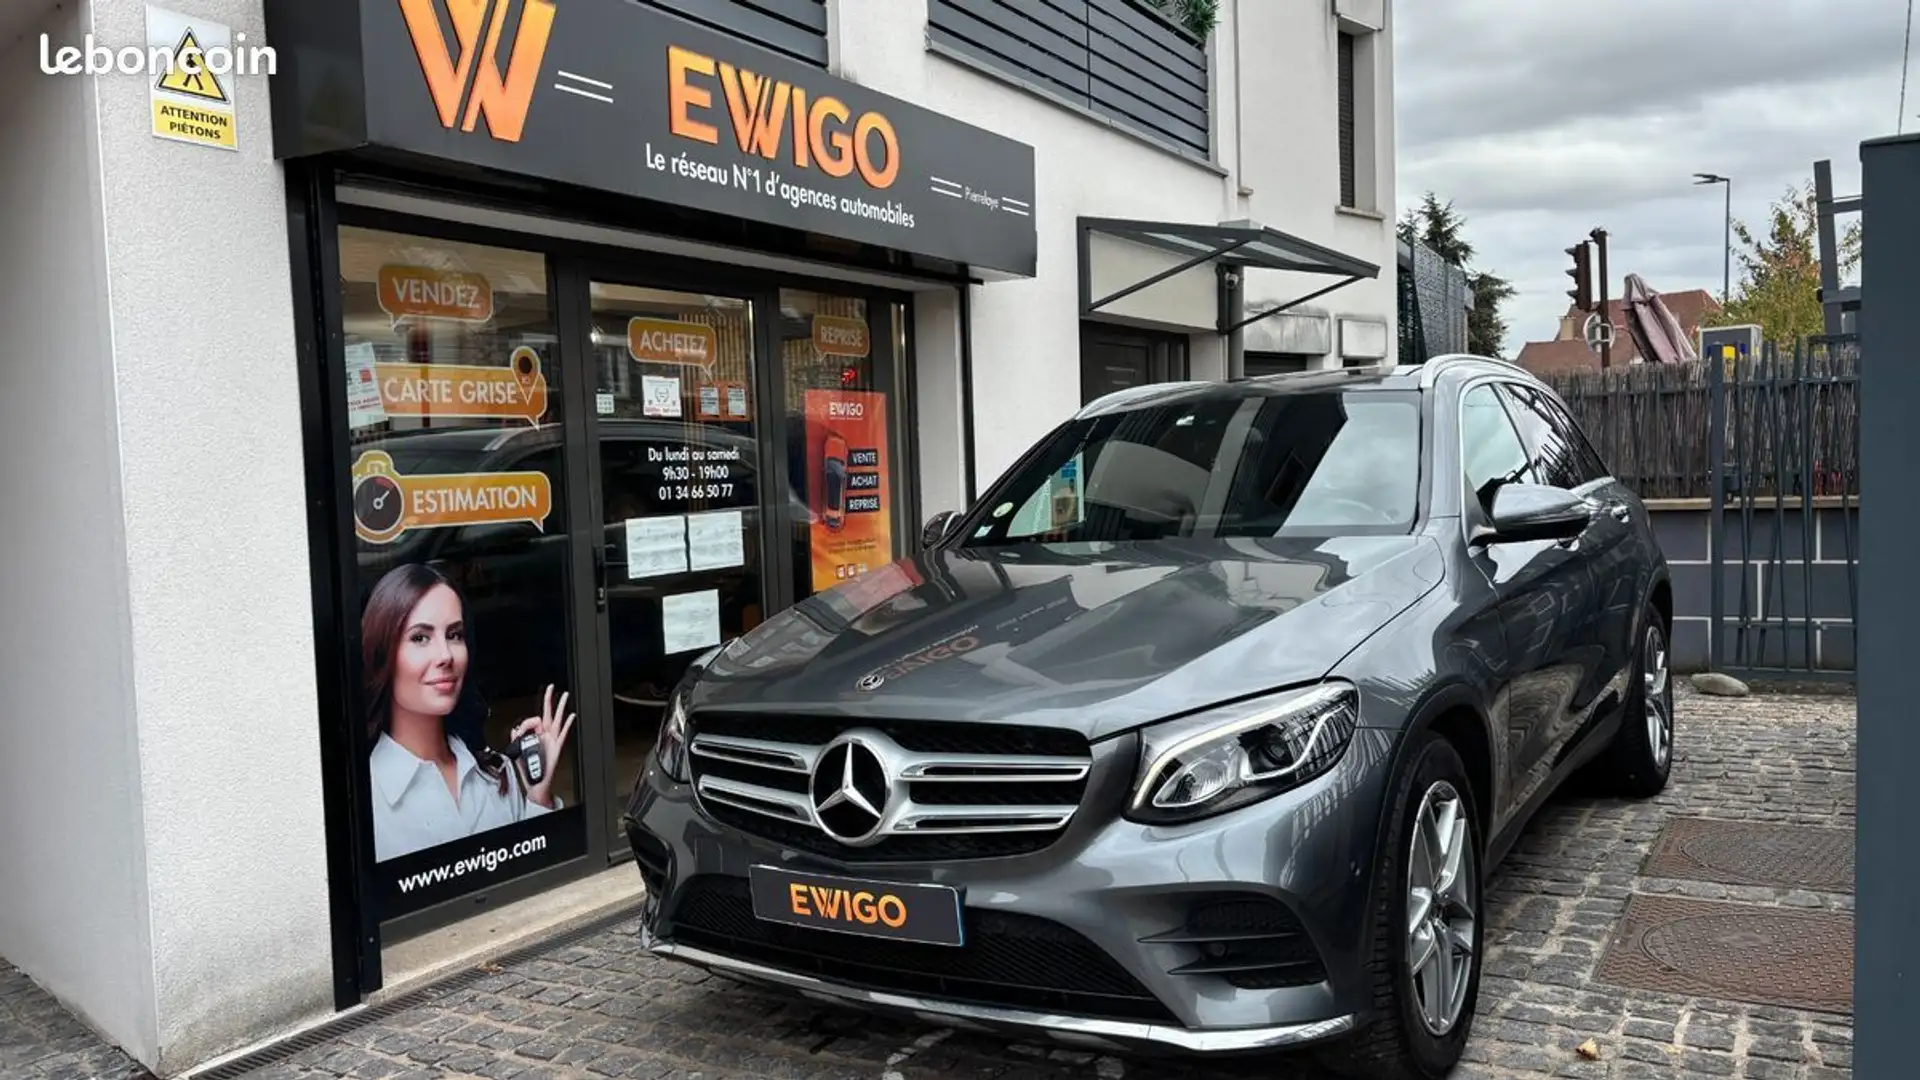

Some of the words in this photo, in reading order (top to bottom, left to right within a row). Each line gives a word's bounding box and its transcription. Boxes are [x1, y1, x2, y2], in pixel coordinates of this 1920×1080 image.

[160, 105, 228, 127] ATTENTION
[667, 45, 900, 189] EWIGO
[169, 120, 222, 141] PIÉTONS
[646, 142, 666, 171] Le
[671, 152, 728, 186] réseau
[841, 197, 915, 228] automobiles
[391, 276, 481, 309] VENDEZ
[640, 328, 707, 355] ACHETEZ
[819, 325, 864, 348] REPRISE
[383, 378, 452, 404] CARTE
[459, 380, 517, 404] GRISE
[829, 402, 864, 417] EWIGO
[648, 447, 663, 461] Du
[665, 446, 689, 461] lundi
[691, 451, 705, 460] au
[706, 446, 740, 461] samedi
[853, 451, 877, 464] VENTE
[662, 465, 689, 480] 9h30
[699, 464, 729, 479] 19h00
[851, 475, 878, 487] ACHAT
[412, 486, 537, 514] ESTIMATION
[659, 486, 672, 500] 01
[675, 485, 689, 499] 34
[691, 485, 704, 498] 66
[706, 484, 720, 498] 50
[721, 483, 734, 497] 77
[849, 498, 879, 510] REPRISE
[398, 834, 547, 894] www.ewigo.com
[790, 882, 907, 929] EWIGO
